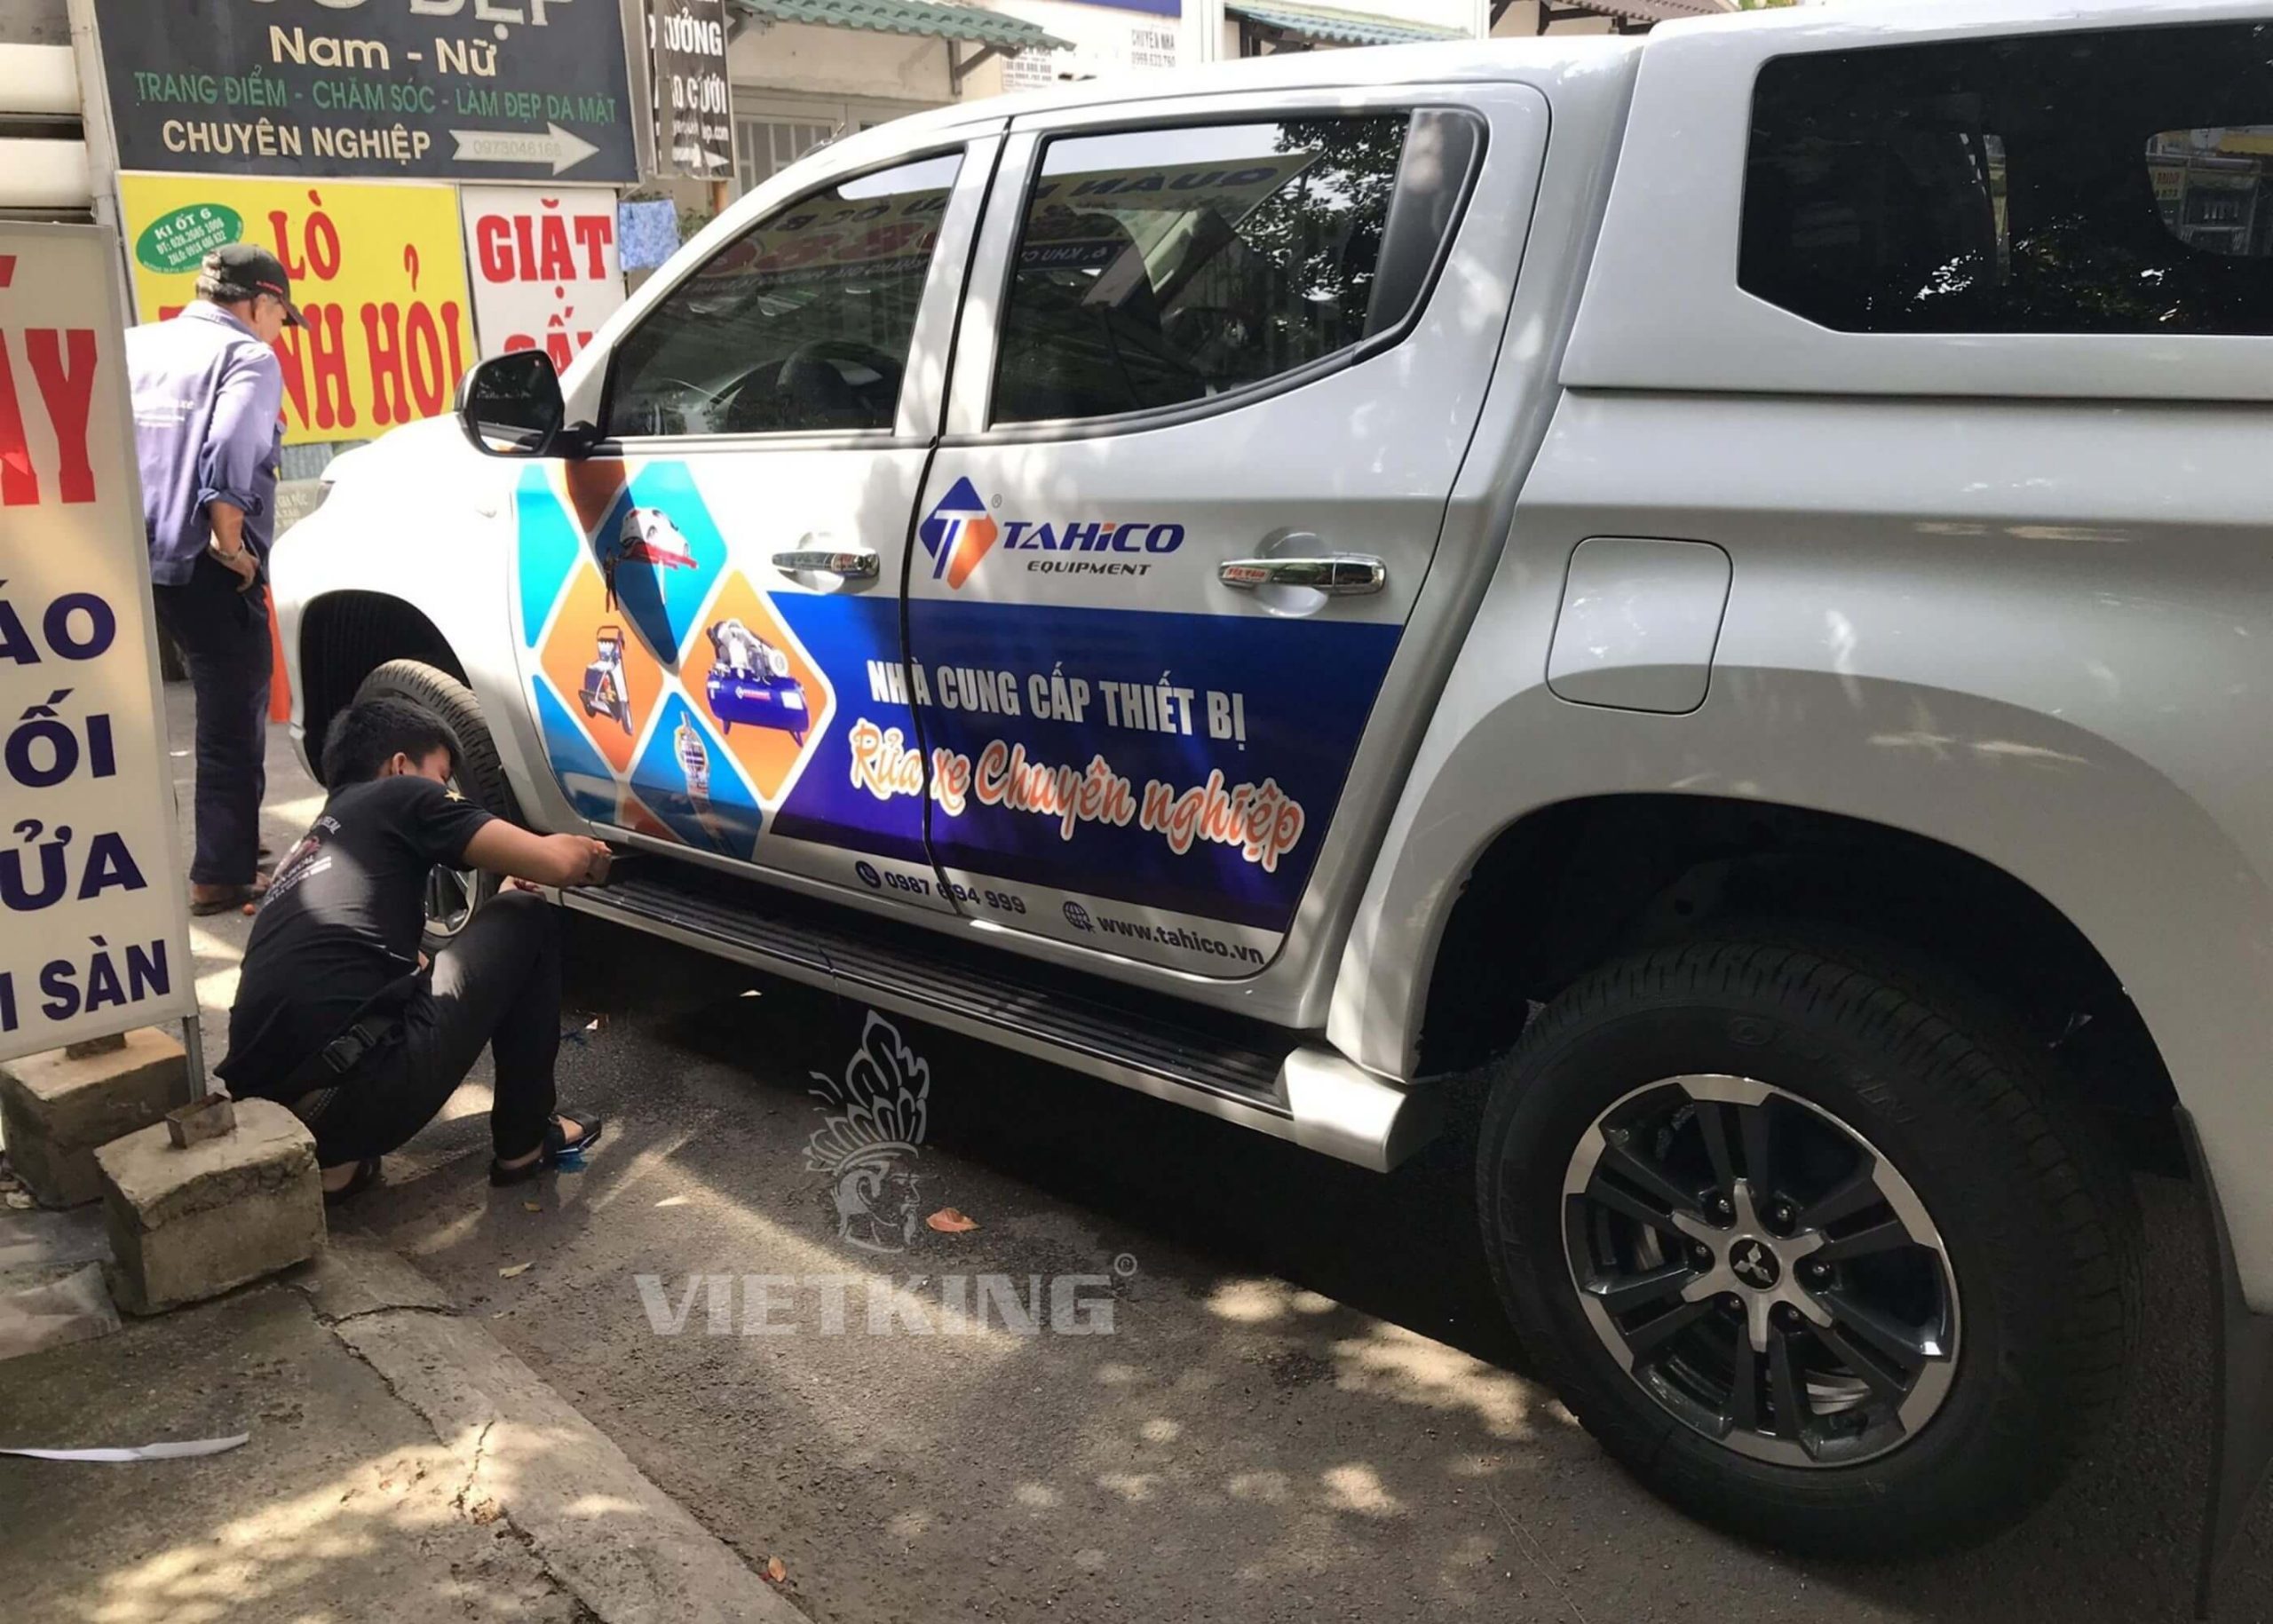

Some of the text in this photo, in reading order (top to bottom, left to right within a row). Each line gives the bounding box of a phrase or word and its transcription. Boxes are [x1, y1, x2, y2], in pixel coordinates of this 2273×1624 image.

[135, 72, 218, 104] TRANG
[224, 65, 287, 107] ĐIỂM
[391, 78, 436, 114] SÓC
[455, 83, 499, 116] LÀM
[504, 91, 541, 123] ĐẸP
[547, 96, 574, 122] DA
[578, 92, 616, 126] MẶT
[269, 26, 390, 69] Nam
[435, 37, 497, 76] Nữ
[162, 117, 431, 165] CHUYÊN NGHIỆP
[268, 189, 341, 281] LÒ
[476, 198, 613, 299] GIẶT
[360, 243, 464, 426] HỎI
[1027, 559, 1152, 576] EQUIPMENT
[867, 657, 1247, 750] NHÀ CUNG CẤP THIẾT BỊ
[849, 717, 1305, 873] Rửa xe Chuyên nghiệp
[884, 871, 930, 896] 0987
[984, 890, 1026, 915] 999
[1097, 916, 1264, 965] www.tahico.vn
[39, 935, 170, 1021] SÀN
